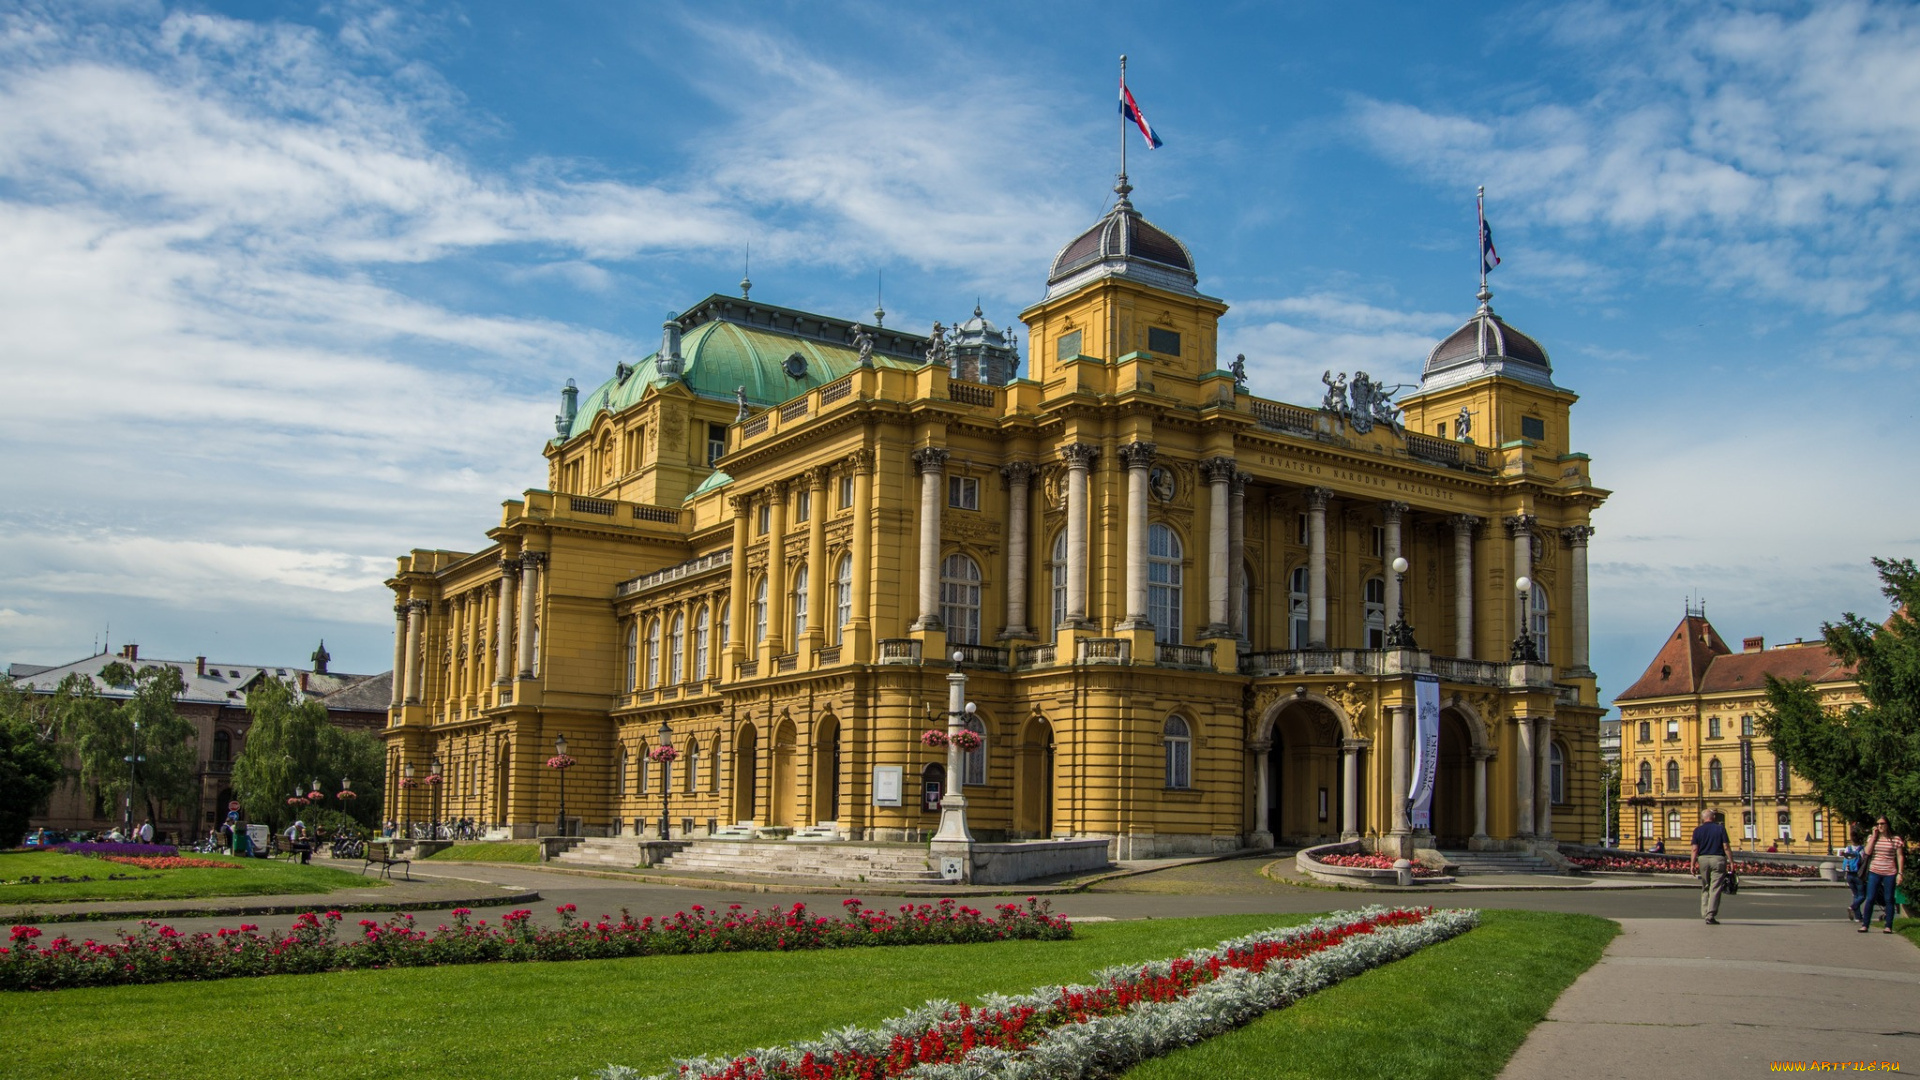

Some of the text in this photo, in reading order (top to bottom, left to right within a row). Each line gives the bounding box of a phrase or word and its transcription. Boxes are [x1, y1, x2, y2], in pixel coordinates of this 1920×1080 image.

[1261, 455, 1454, 500] HRVATSKO NARODNO KAZALIŠTE
